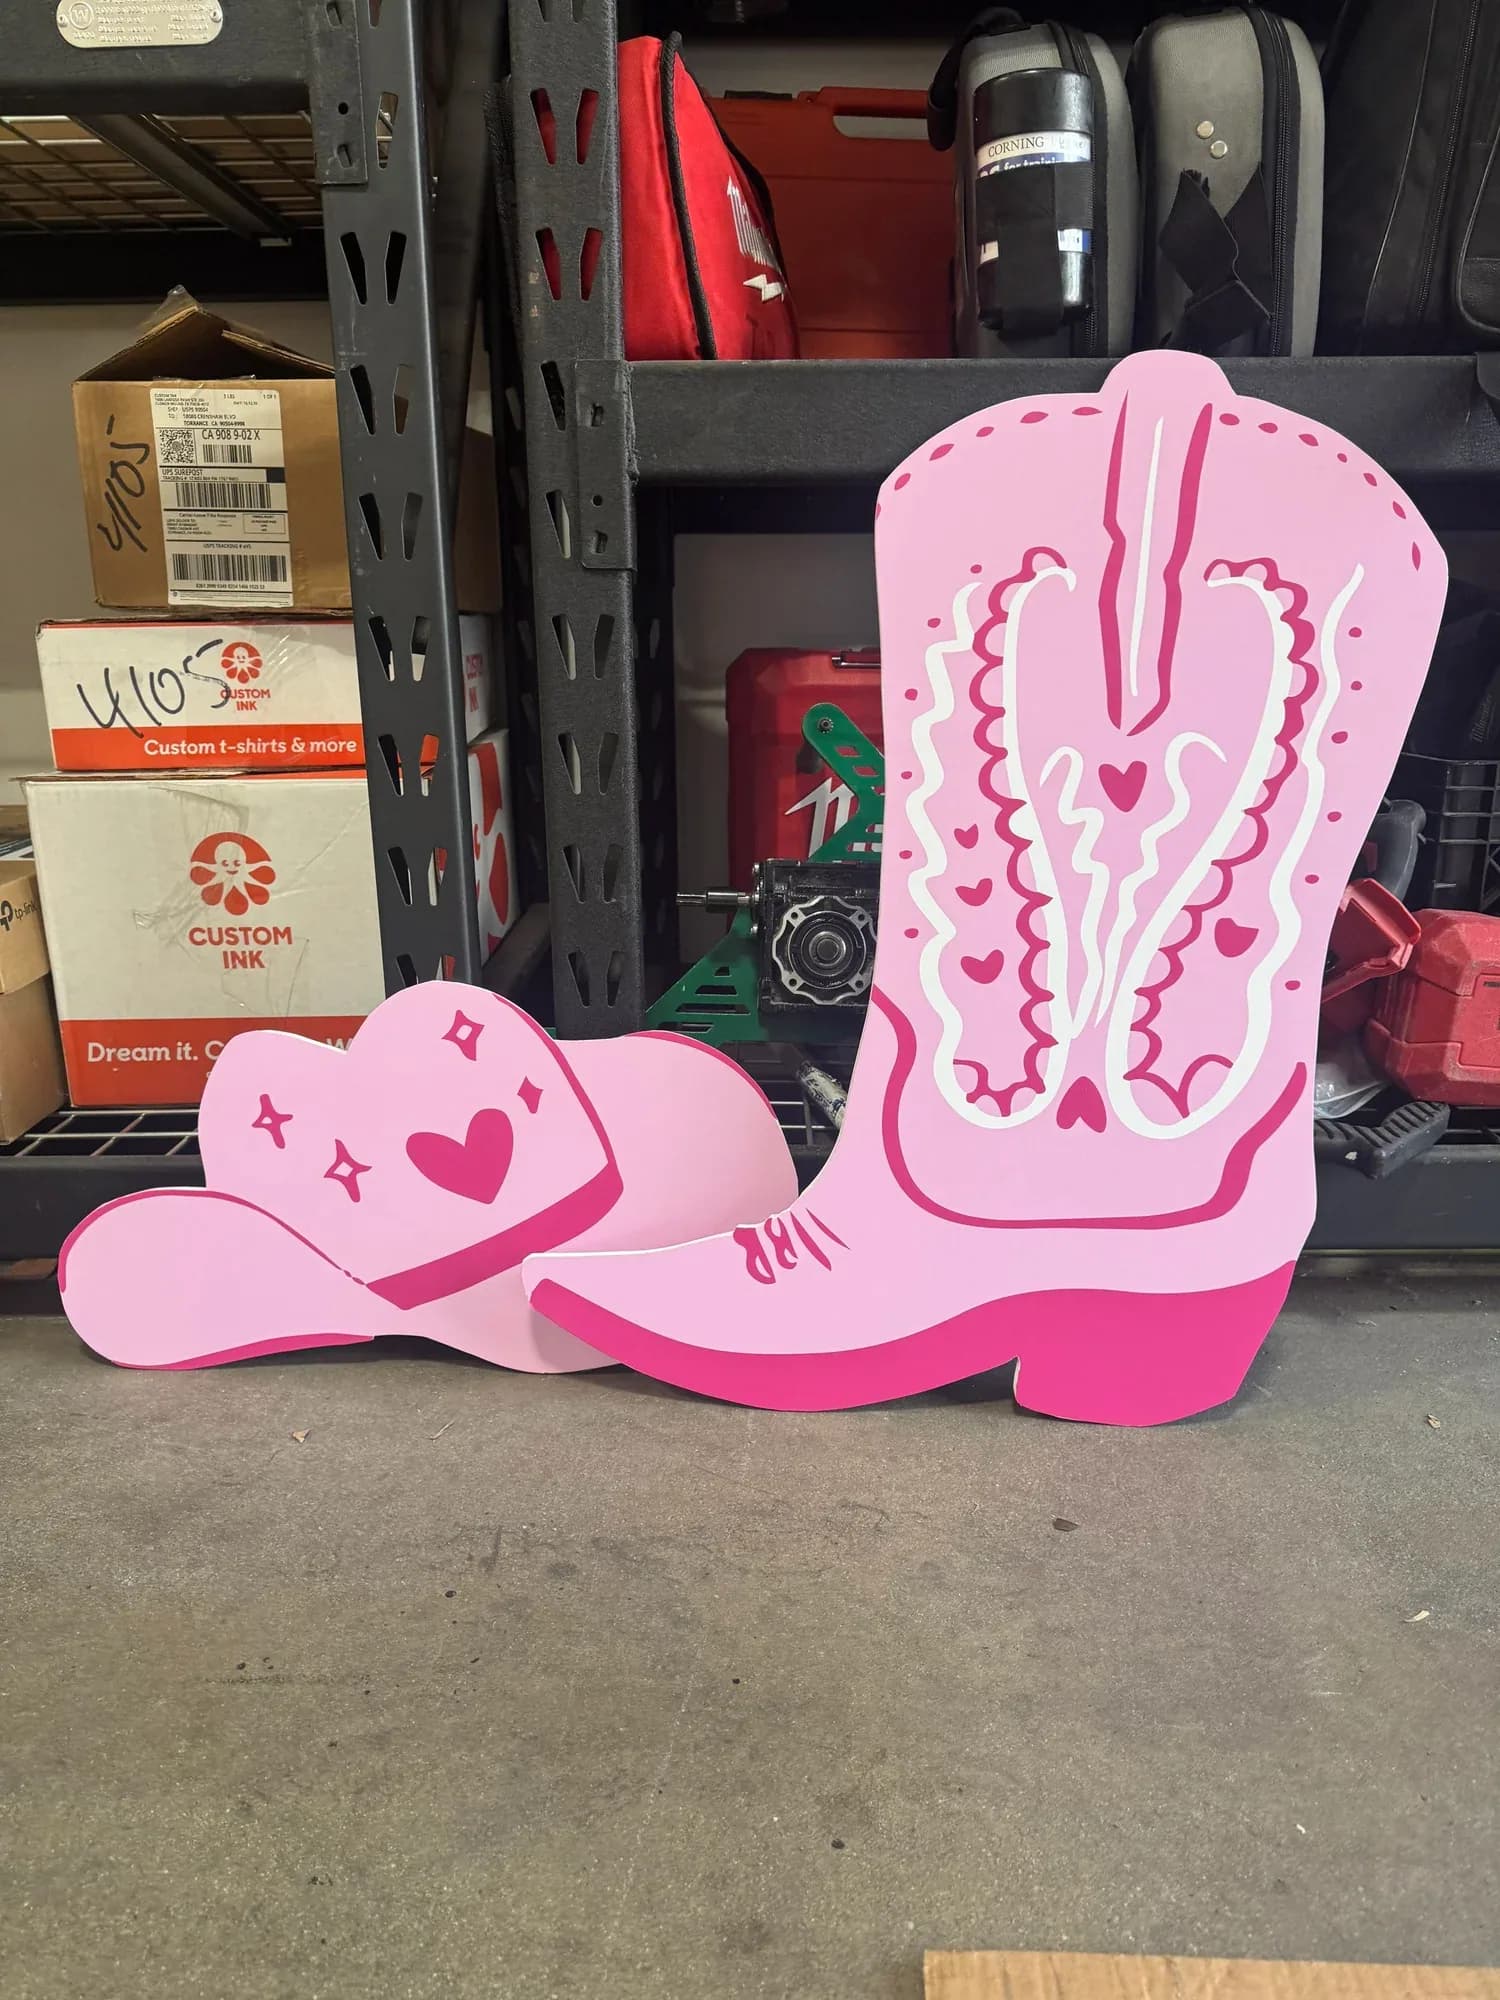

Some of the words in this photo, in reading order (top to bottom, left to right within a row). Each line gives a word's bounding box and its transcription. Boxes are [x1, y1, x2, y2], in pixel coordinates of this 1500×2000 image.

[988, 136, 1045, 158] CORNING
[201, 430, 214, 440] CA
[215, 430, 232, 441] 908
[233, 430, 252, 441] 9-02
[253, 430, 261, 441] X
[76, 638, 232, 739] 4105
[220, 688, 271, 700] CUSTOM
[235, 700, 258, 712] INK
[143, 738, 216, 756] Custom
[219, 737, 288, 754] t-shirts
[290, 738, 306, 754] &
[309, 740, 358, 754] more
[188, 925, 293, 946] CUSTOM
[222, 949, 266, 970] INK
[87, 1041, 173, 1064] Dream
[175, 1039, 199, 1062] it.
